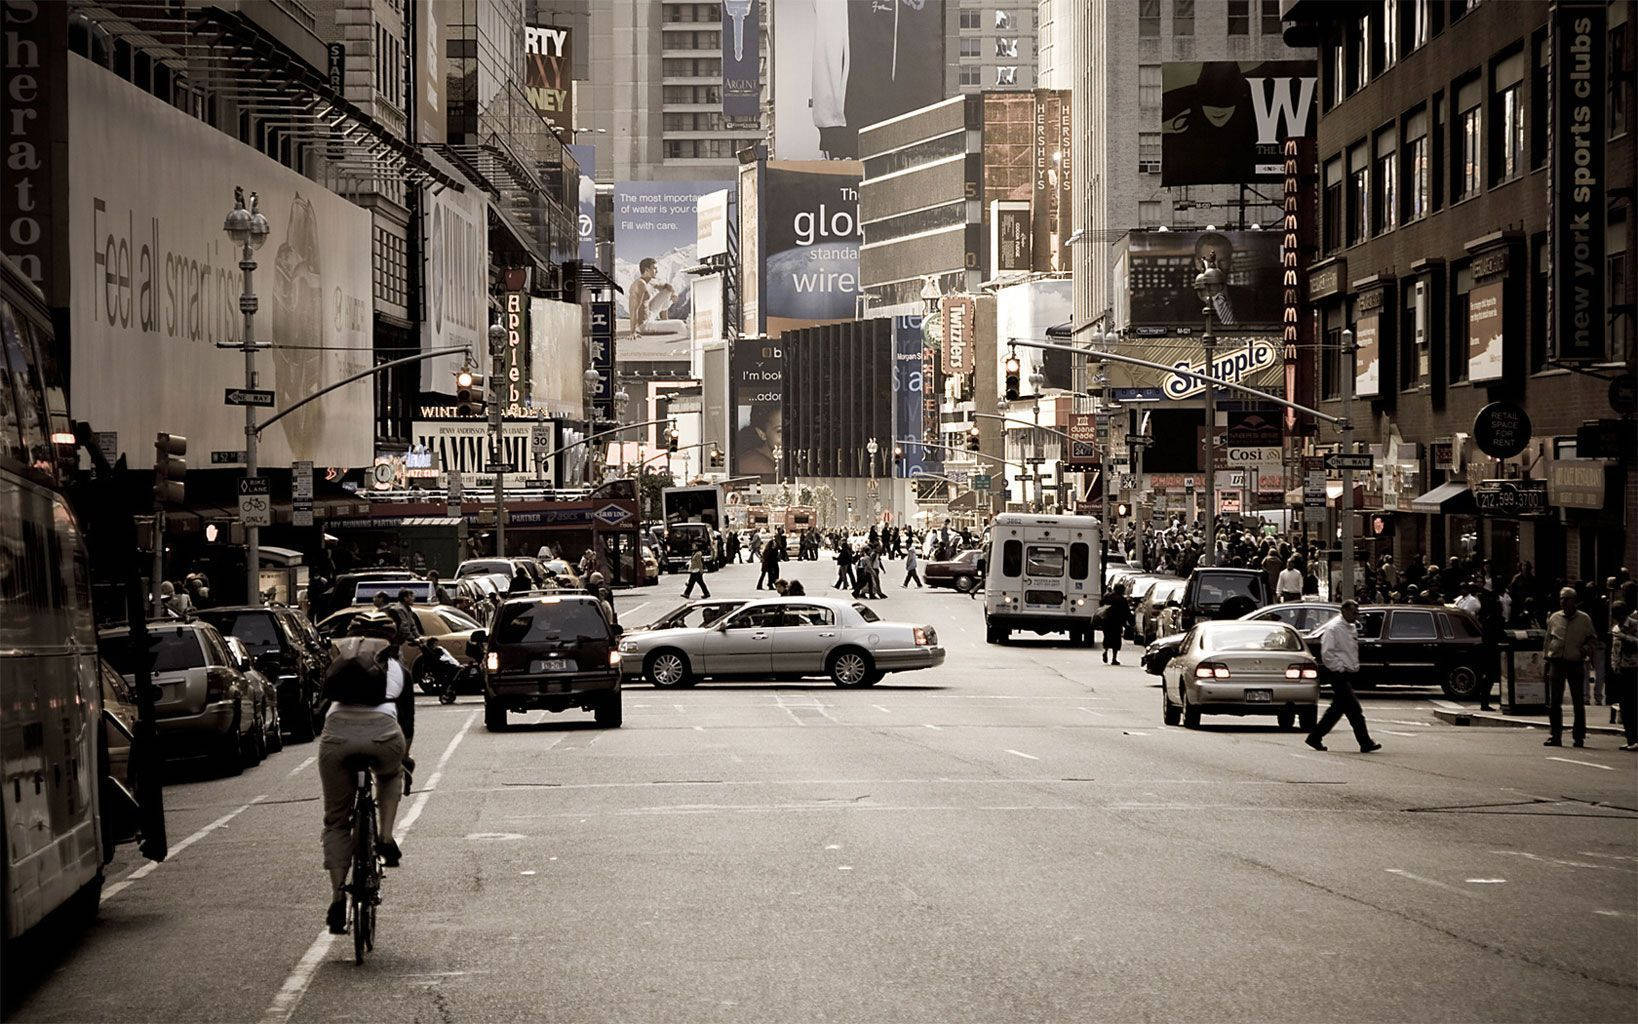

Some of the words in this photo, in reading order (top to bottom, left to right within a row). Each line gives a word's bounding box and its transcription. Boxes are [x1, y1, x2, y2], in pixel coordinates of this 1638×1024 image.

[1570, 16, 1592, 98] clubs
[5, 0, 43, 282] Sheraton
[1571, 104, 1596, 203] sports
[620, 193, 637, 203] The
[640, 194, 661, 203] most
[664, 193, 705, 205] importa
[620, 205, 630, 214] of
[632, 205, 656, 214] water
[660, 205, 668, 214] is
[670, 206, 690, 215] your
[622, 221, 634, 230] Fill
[635, 221, 655, 230] with
[656, 222, 679, 231] care.
[1570, 211, 1595, 278] york
[93, 197, 134, 330] Feel
[139, 217, 160, 333] all
[166, 241, 211, 343] smart
[1574, 285, 1590, 348] new
[950, 303, 967, 369] Twizzlers
[743, 371, 760, 380] I'm
[421, 406, 480, 418] WINT
[1491, 411, 1518, 420] RETAIL
[1071, 425, 1095, 434] duane
[1491, 421, 1518, 430] SPACE
[533, 437, 548, 446] 30
[1493, 438, 1515, 447] RENT
[511, 514, 541, 523] PARTNER
